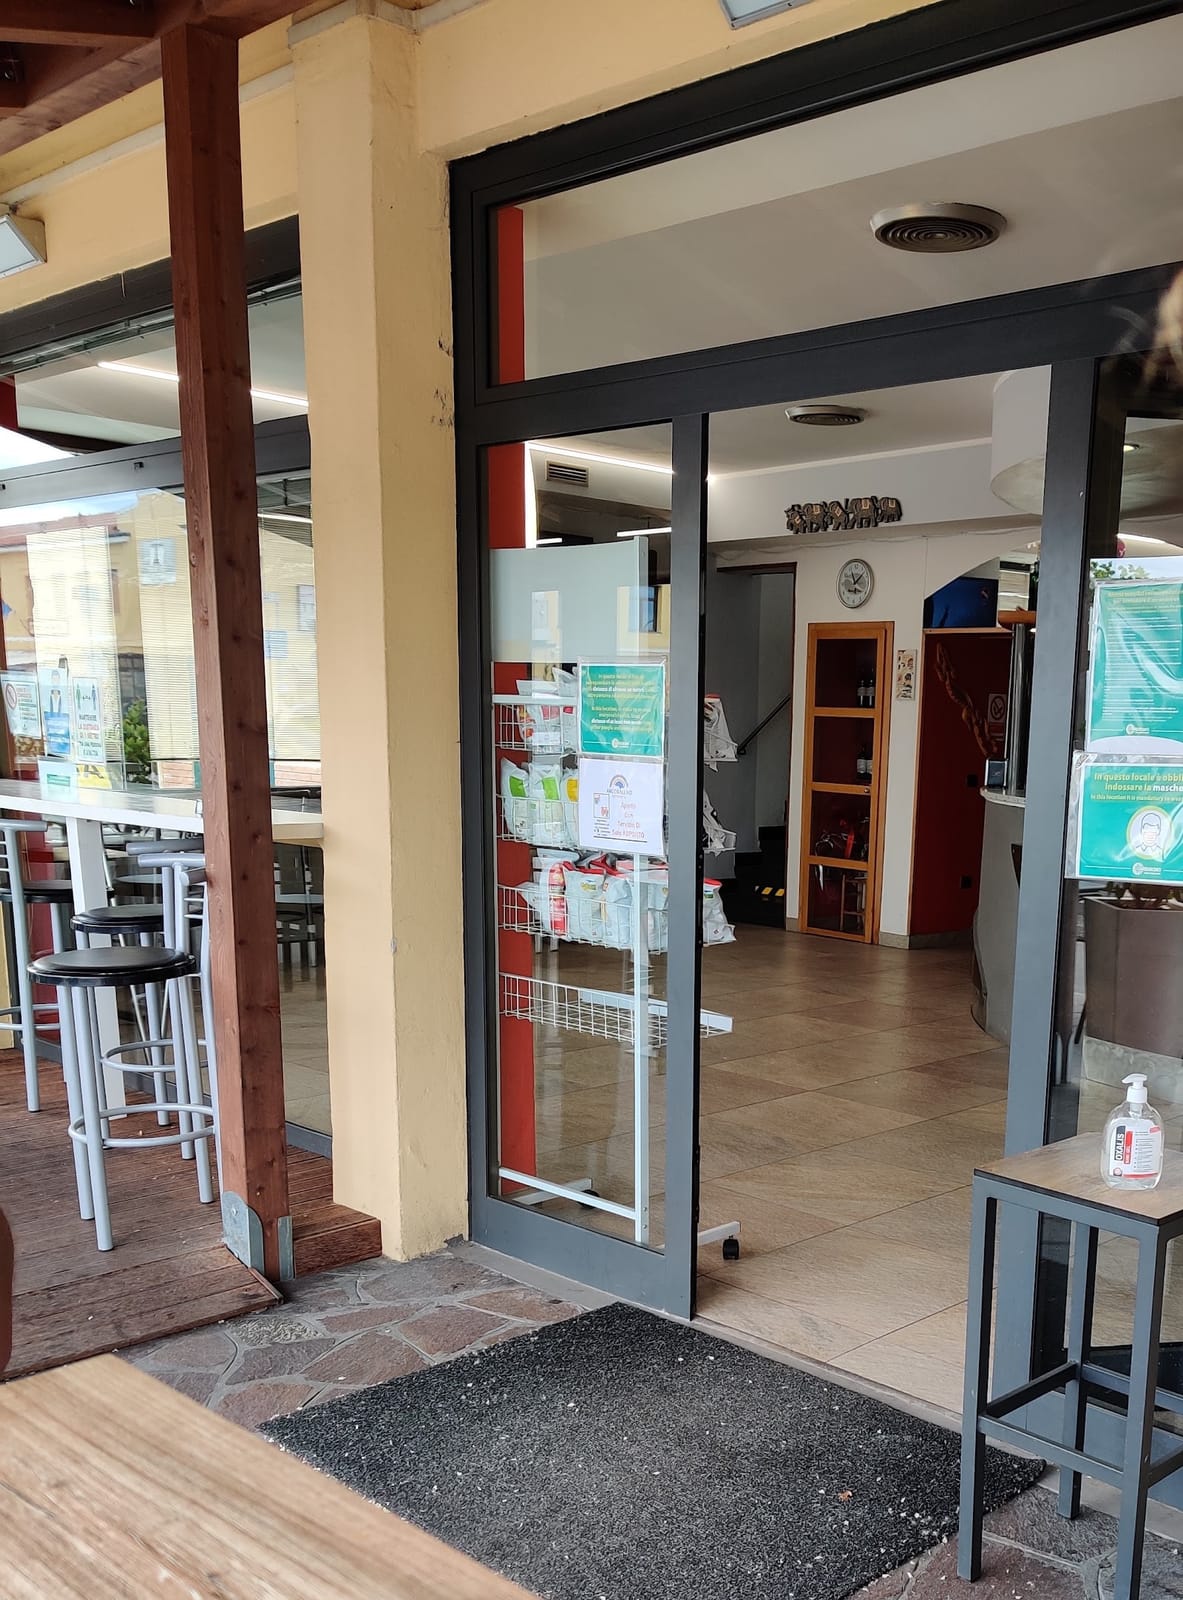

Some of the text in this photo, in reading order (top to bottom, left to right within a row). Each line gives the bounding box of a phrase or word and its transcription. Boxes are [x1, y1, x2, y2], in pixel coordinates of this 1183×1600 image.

[1094, 773, 1102, 781] In
[1103, 773, 1130, 783] questo
[1131, 772, 1155, 781] locale
[1144, 783, 1152, 791] la
[1115, 1133, 1125, 1160] OXALIS
